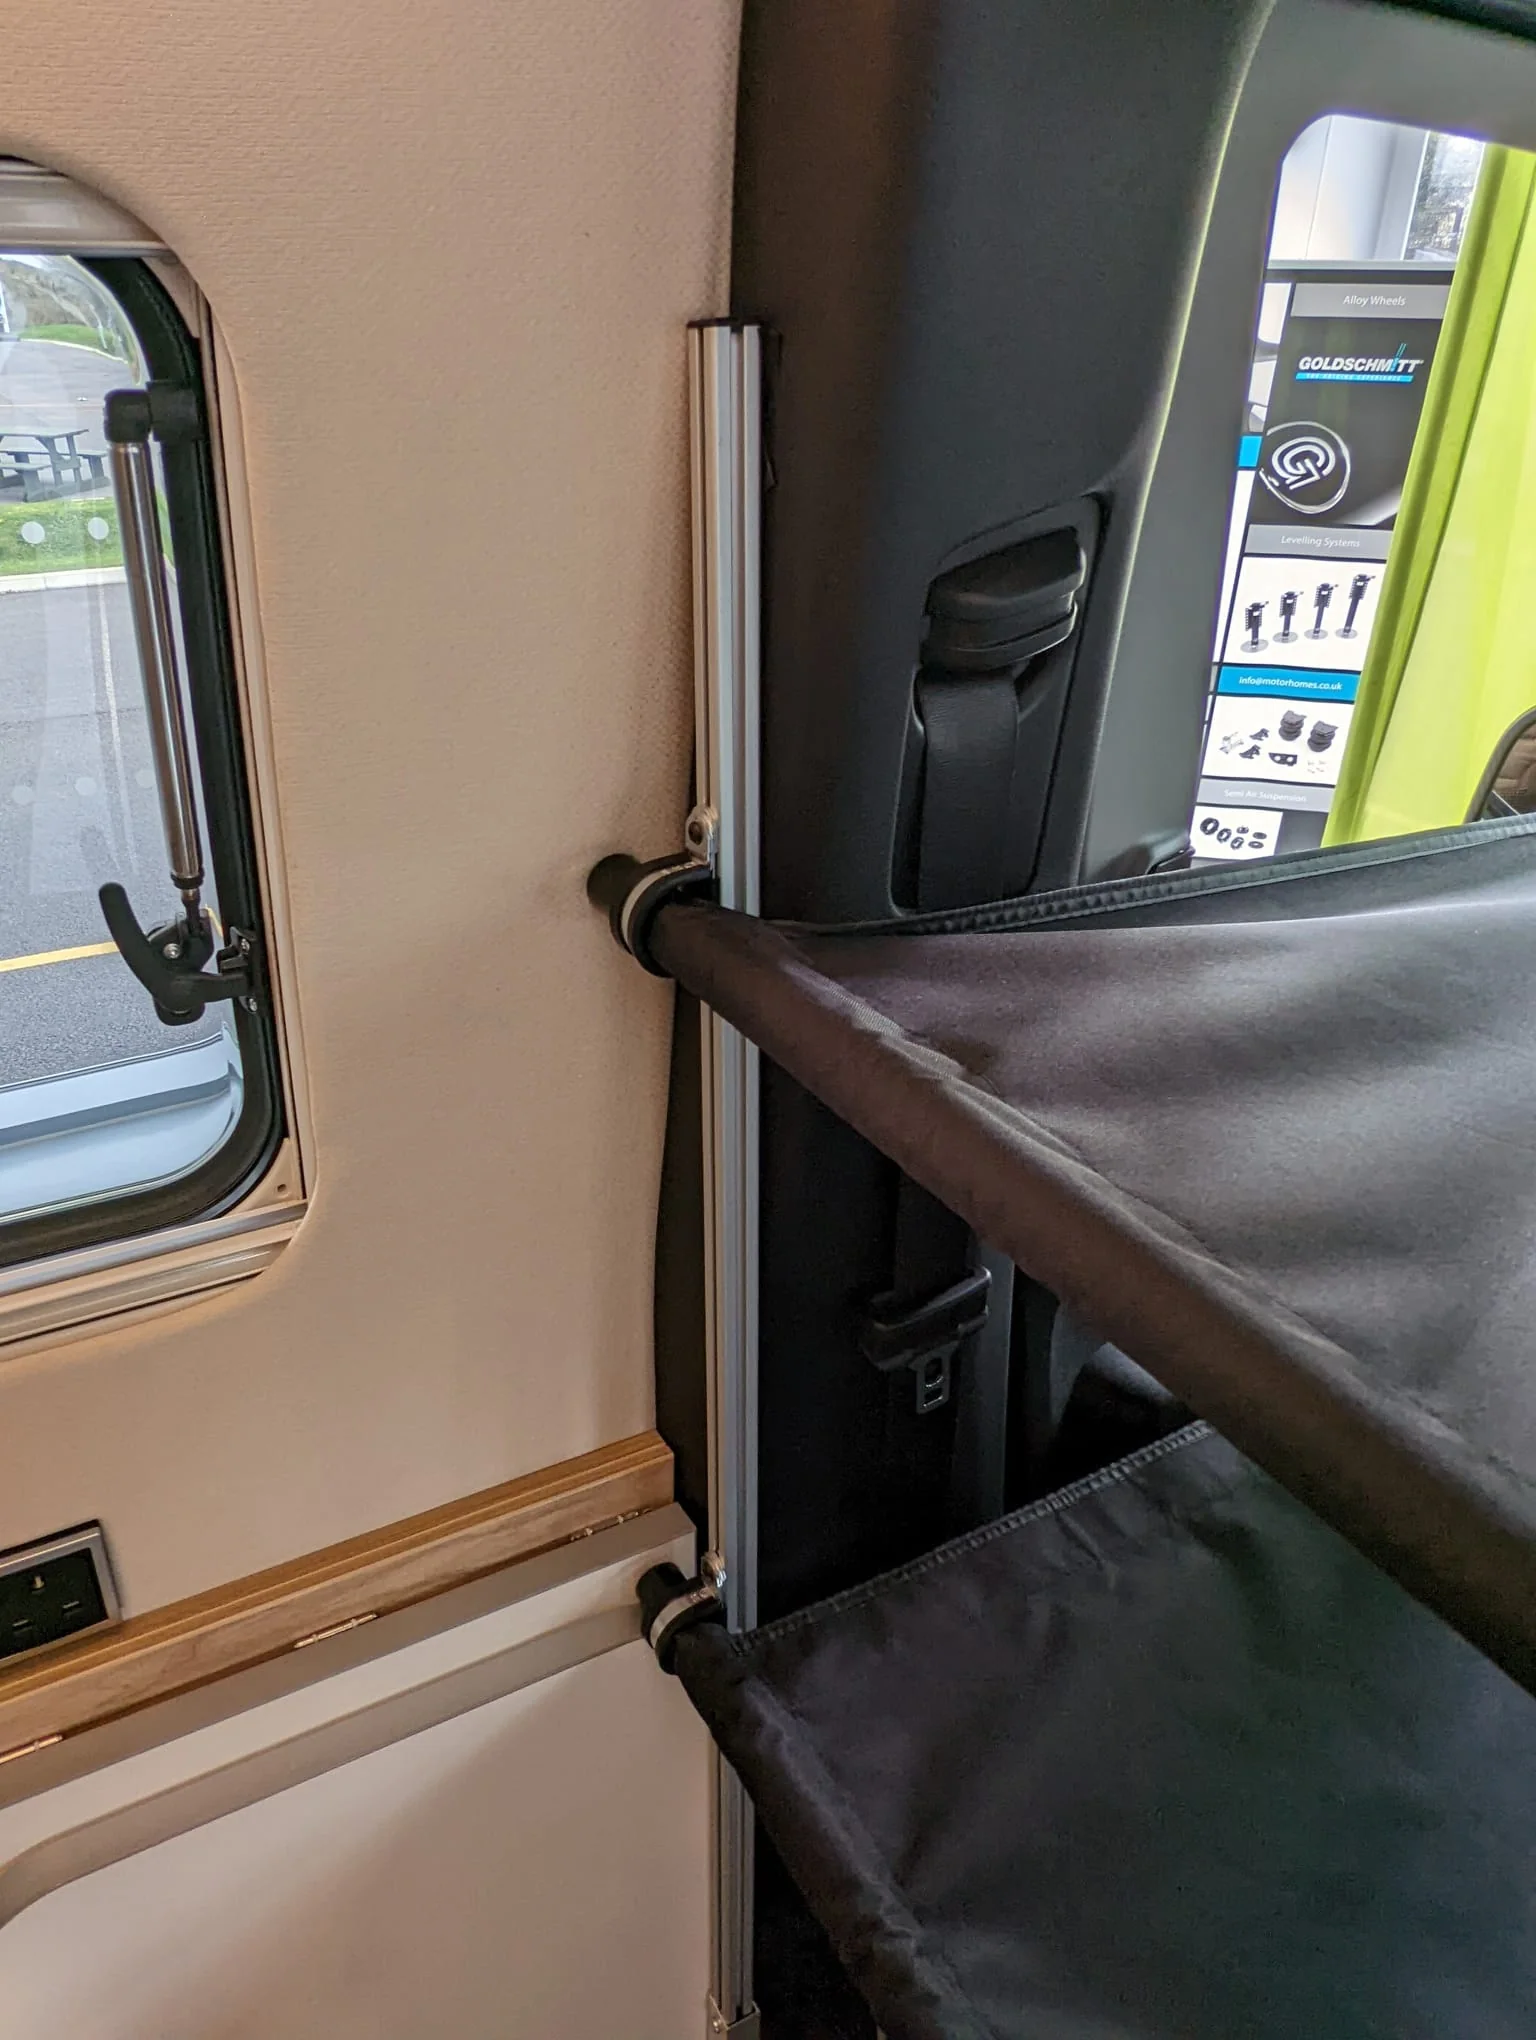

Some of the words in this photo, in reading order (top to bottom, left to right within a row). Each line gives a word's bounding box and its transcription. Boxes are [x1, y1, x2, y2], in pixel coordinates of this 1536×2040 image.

[1342, 295, 1368, 307] Alloy
[1370, 295, 1406, 306] Wheels
[1298, 343, 1424, 373] GOLDSCHMITT
[1281, 535, 1322, 548] Levelling
[1323, 537, 1361, 549] Systems
[1239, 676, 1343, 690] info@motorhomes.co.uk
